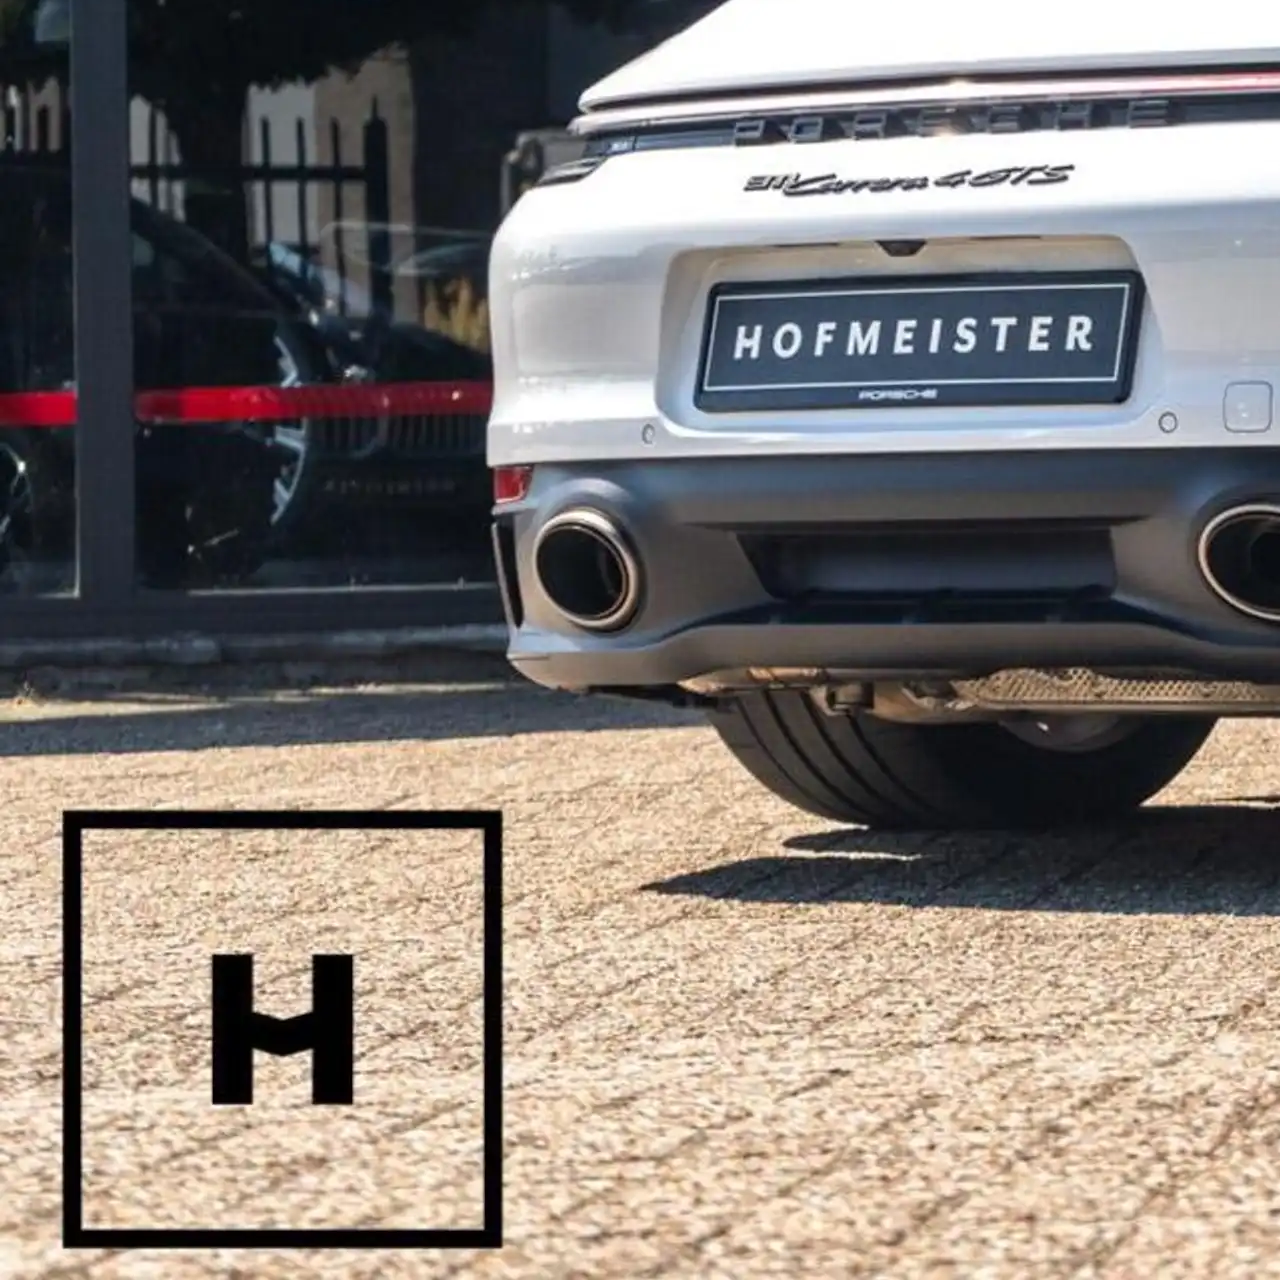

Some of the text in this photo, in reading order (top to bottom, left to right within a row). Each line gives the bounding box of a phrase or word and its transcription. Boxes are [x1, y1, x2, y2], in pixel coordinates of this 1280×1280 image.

[734, 100, 1168, 147] PORSCHE
[783, 173, 929, 197] Carrera
[934, 169, 972, 189] 4
[971, 164, 1075, 187] GTS
[734, 314, 1095, 360] HOFMEISTER
